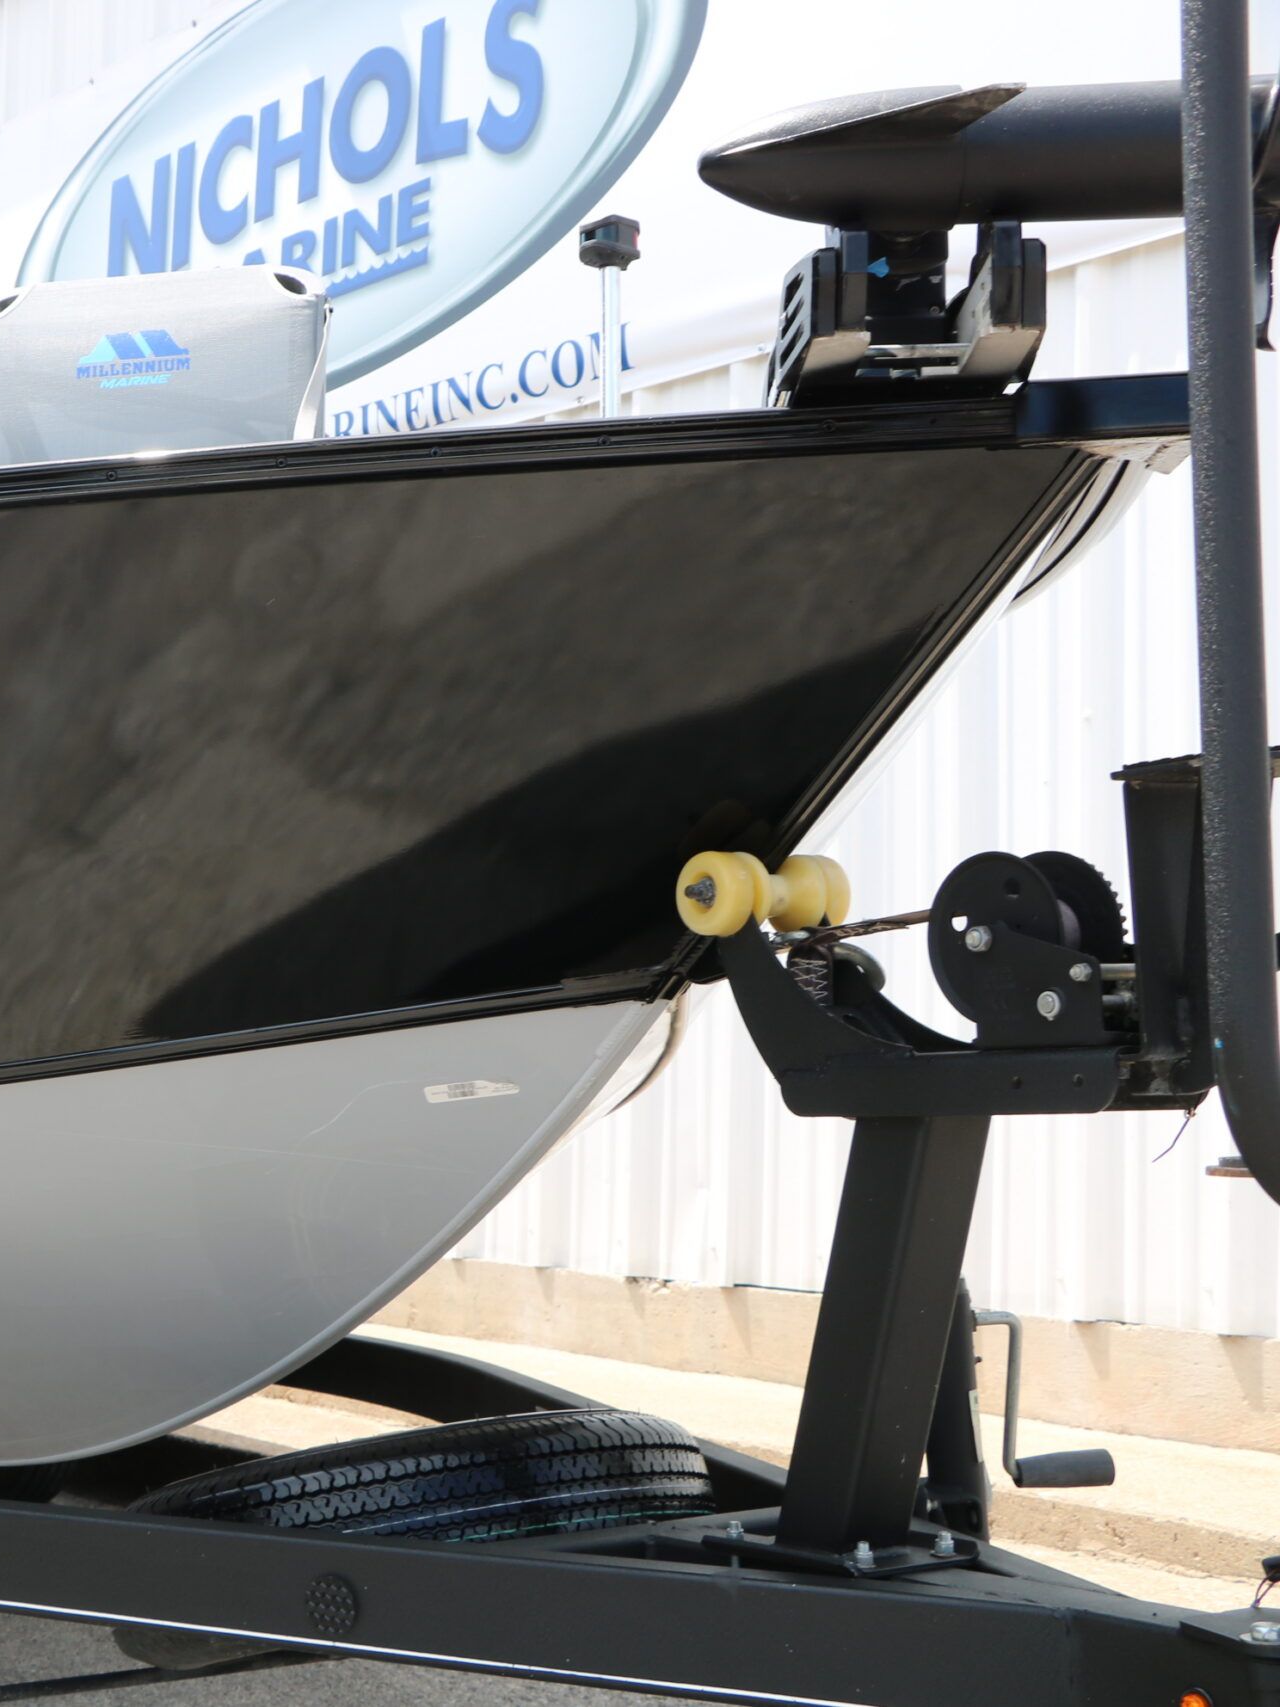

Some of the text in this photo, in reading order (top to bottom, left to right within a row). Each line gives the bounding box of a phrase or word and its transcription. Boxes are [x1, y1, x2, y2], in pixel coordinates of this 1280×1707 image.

[107, 0, 544, 277] NICHOLS
[243, 177, 431, 277] RINE
[76, 357, 191, 379] MILLENNIUM
[99, 373, 171, 389] MARINE
